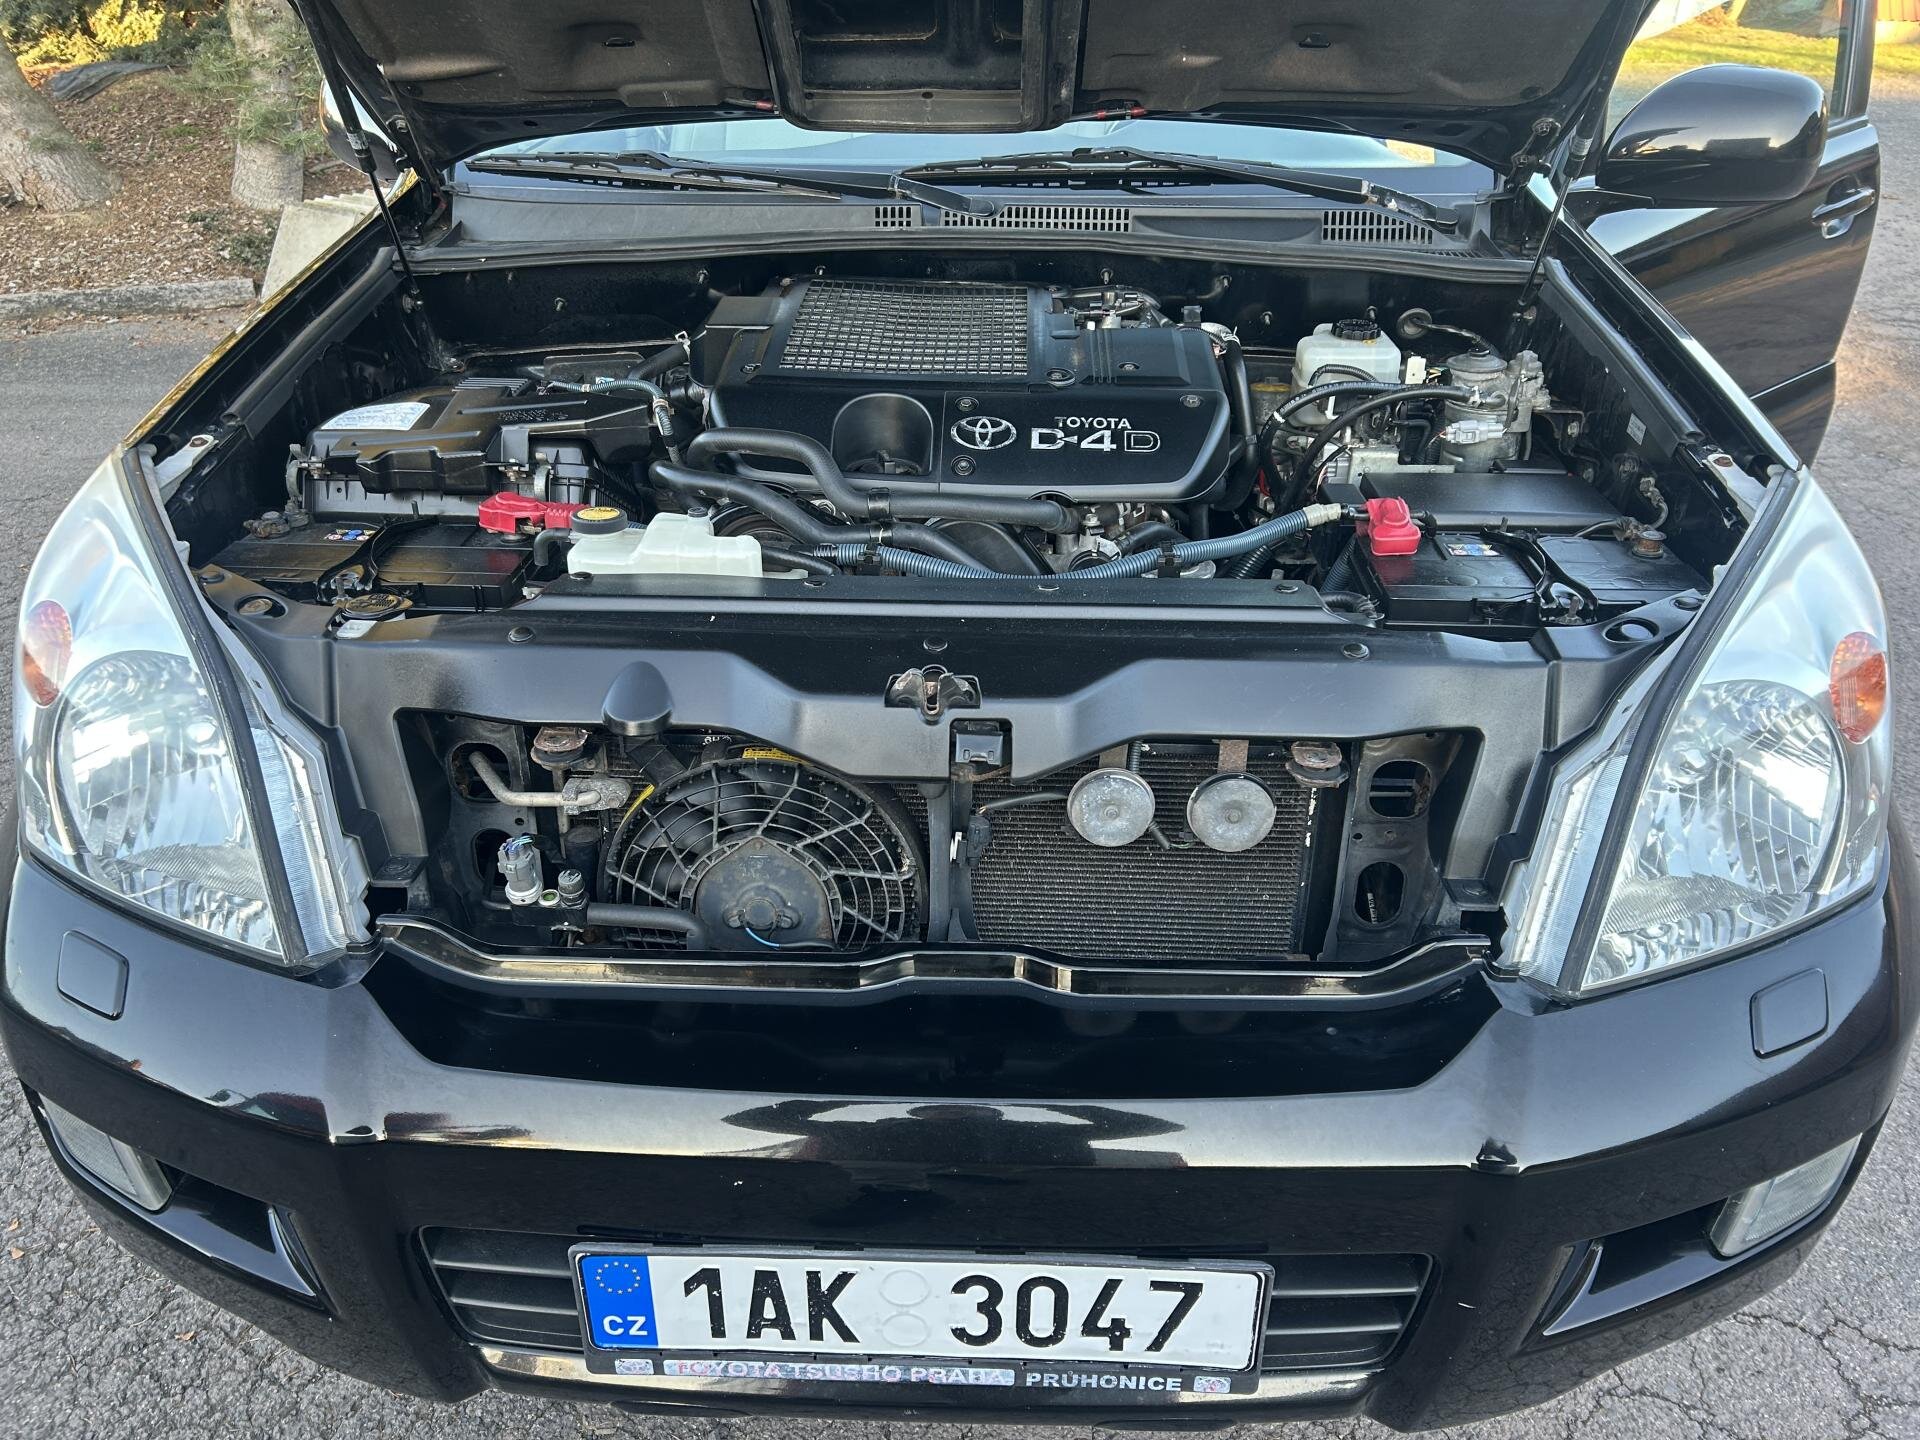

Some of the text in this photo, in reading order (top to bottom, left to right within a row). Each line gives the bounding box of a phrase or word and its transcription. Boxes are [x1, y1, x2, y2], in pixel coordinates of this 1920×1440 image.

[1054, 416, 1132, 430] TOYOTA
[683, 1267, 1204, 1353] 1AK 3047
[602, 1314, 649, 1336] CZ
[676, 1360, 781, 1379] TOYOTA
